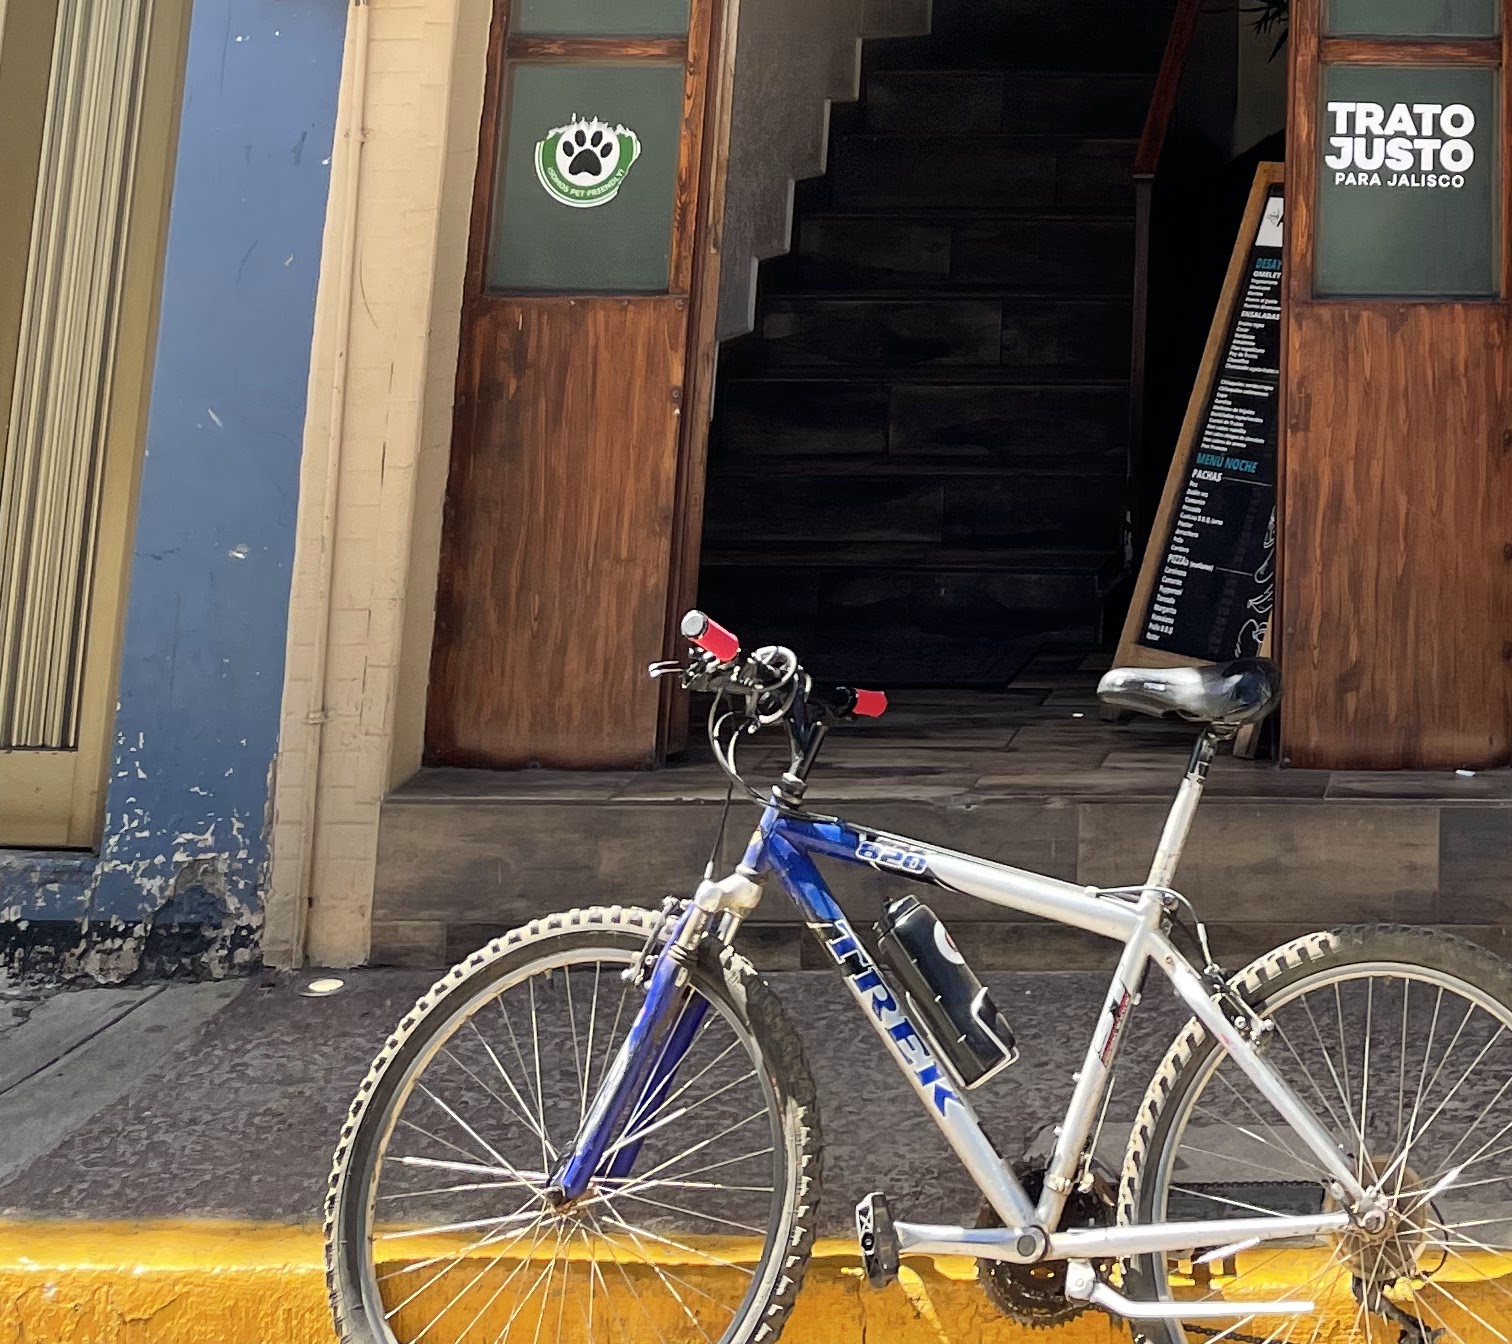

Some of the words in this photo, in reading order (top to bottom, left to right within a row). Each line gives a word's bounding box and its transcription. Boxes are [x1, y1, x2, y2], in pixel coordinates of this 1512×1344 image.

[1327, 101, 1475, 138] TRATO
[1324, 137, 1475, 173] JUSTO
[1334, 172, 1382, 187] PARA
[1387, 172, 1465, 189] JALISCO
[855, 840, 928, 874] 820
[823, 919, 965, 1116] TREK
